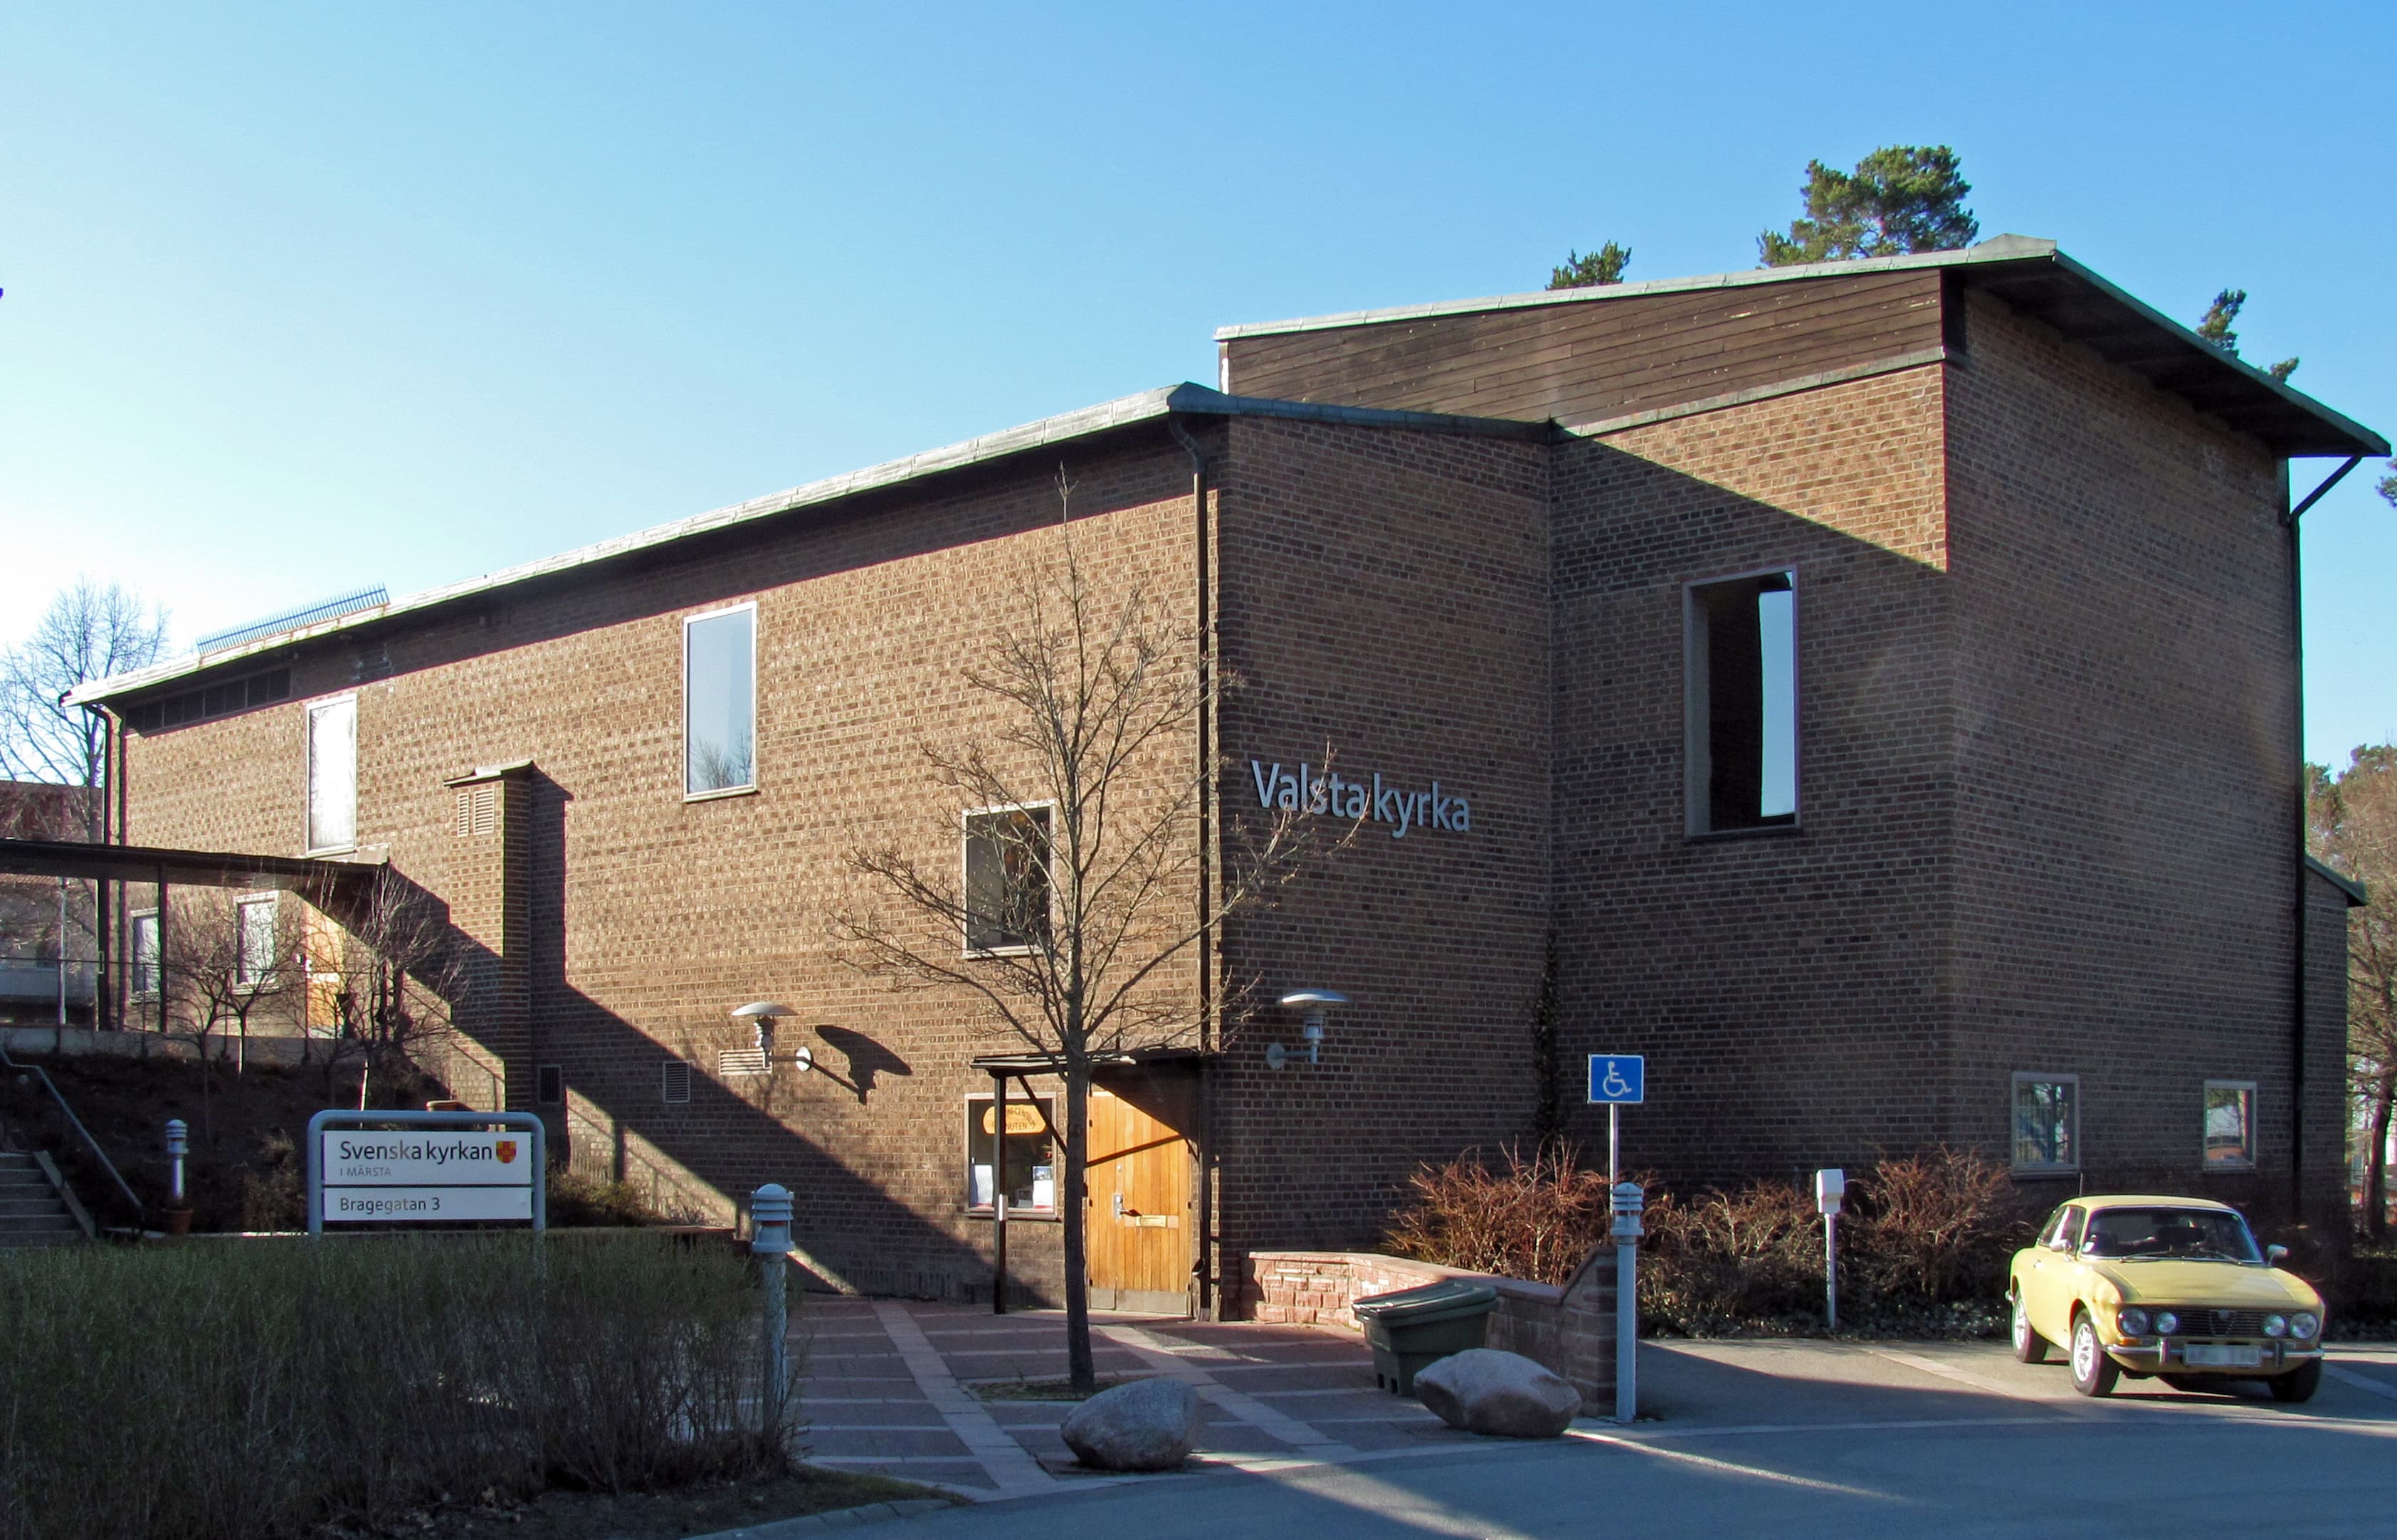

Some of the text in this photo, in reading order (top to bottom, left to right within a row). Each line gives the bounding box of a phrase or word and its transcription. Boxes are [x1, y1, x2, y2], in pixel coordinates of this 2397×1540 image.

[1251, 759, 1469, 838] Valsta kyrka
[340, 1140, 492, 1164] Svenska kyrkan
[340, 1165, 391, 1176] I MÄRSTA
[340, 1198, 441, 1213] Bragegatan 3
